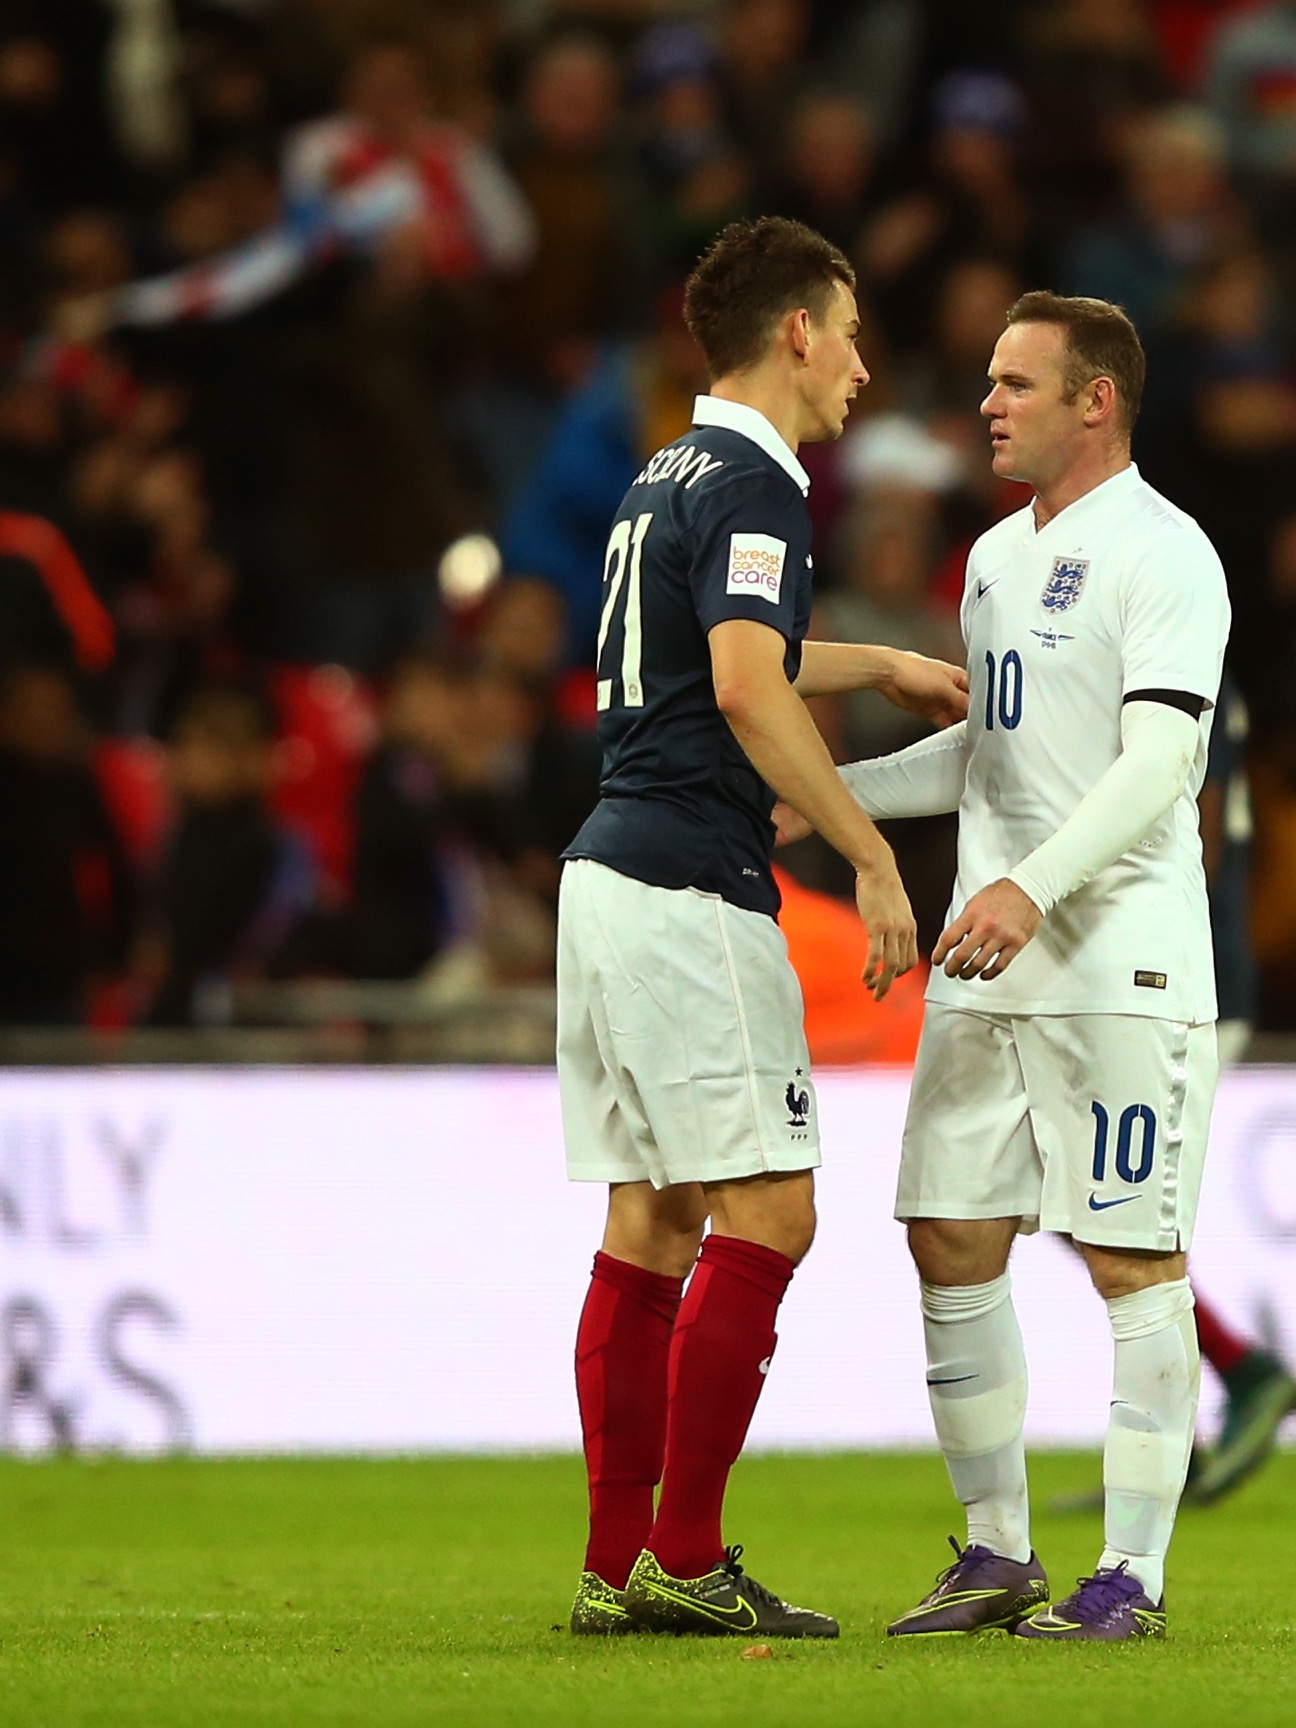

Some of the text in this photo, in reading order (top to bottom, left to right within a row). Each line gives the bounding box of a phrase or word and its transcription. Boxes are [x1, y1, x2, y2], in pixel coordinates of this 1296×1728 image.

[731, 570, 778, 592] care
[732, 561, 780, 577] cancer
[733, 545, 781, 568] breast
[597, 513, 653, 711] 21
[985, 649, 1024, 731] 10
[1091, 1100, 1157, 1184] 10
